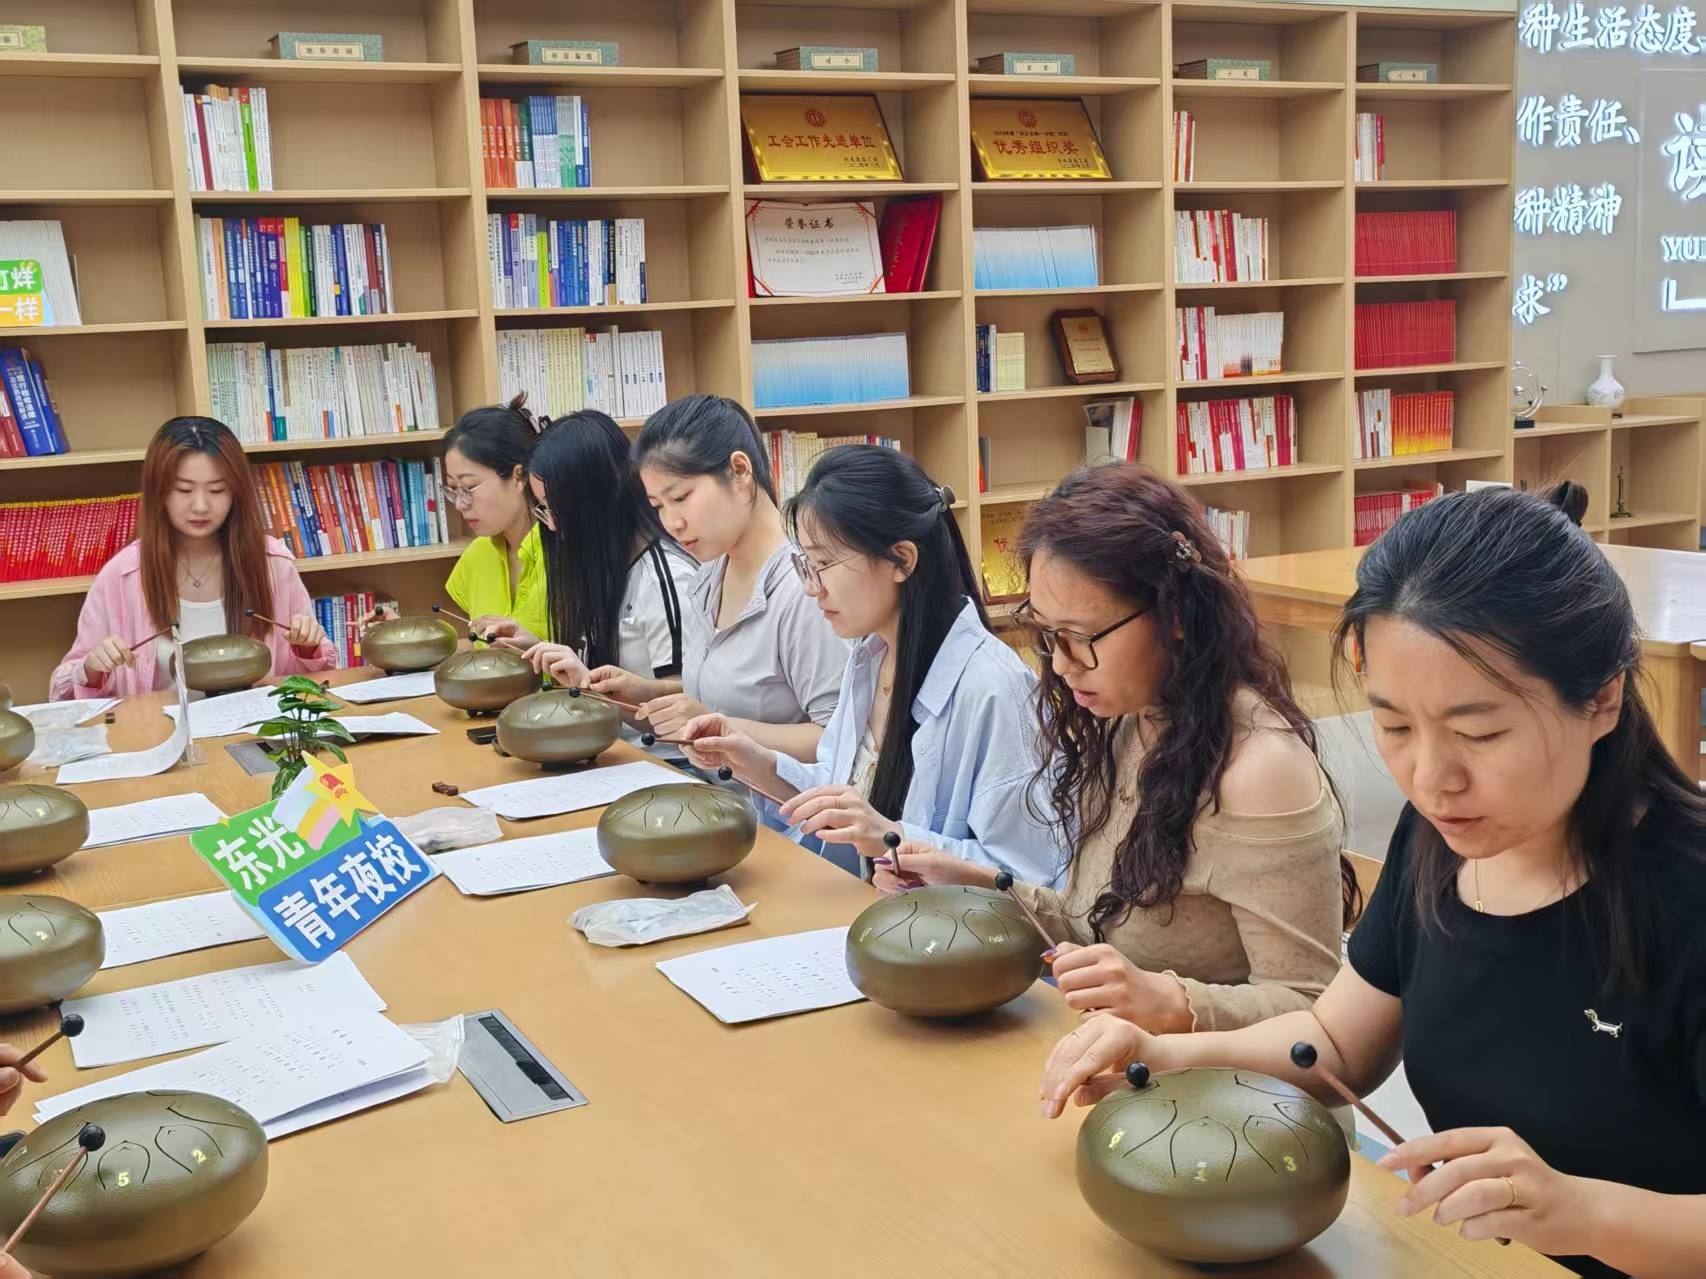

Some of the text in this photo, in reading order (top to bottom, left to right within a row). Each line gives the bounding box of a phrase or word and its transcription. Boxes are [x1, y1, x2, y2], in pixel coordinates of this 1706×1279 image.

[1516, 94, 1640, 147] 作责任、
[768, 133, 877, 149] 工会工作先进单位
[992, 139, 1080, 155] 优秀组织奖
[1514, 183, 1622, 235] 种精神
[784, 217, 834, 230] 荣誉证书
[213, 816, 305, 890] 东光
[273, 834, 422, 949] 青年夜校
[192, 1148, 207, 1164] 2
[1283, 1155, 1297, 1172] 3
[117, 1171, 131, 1188] 5
